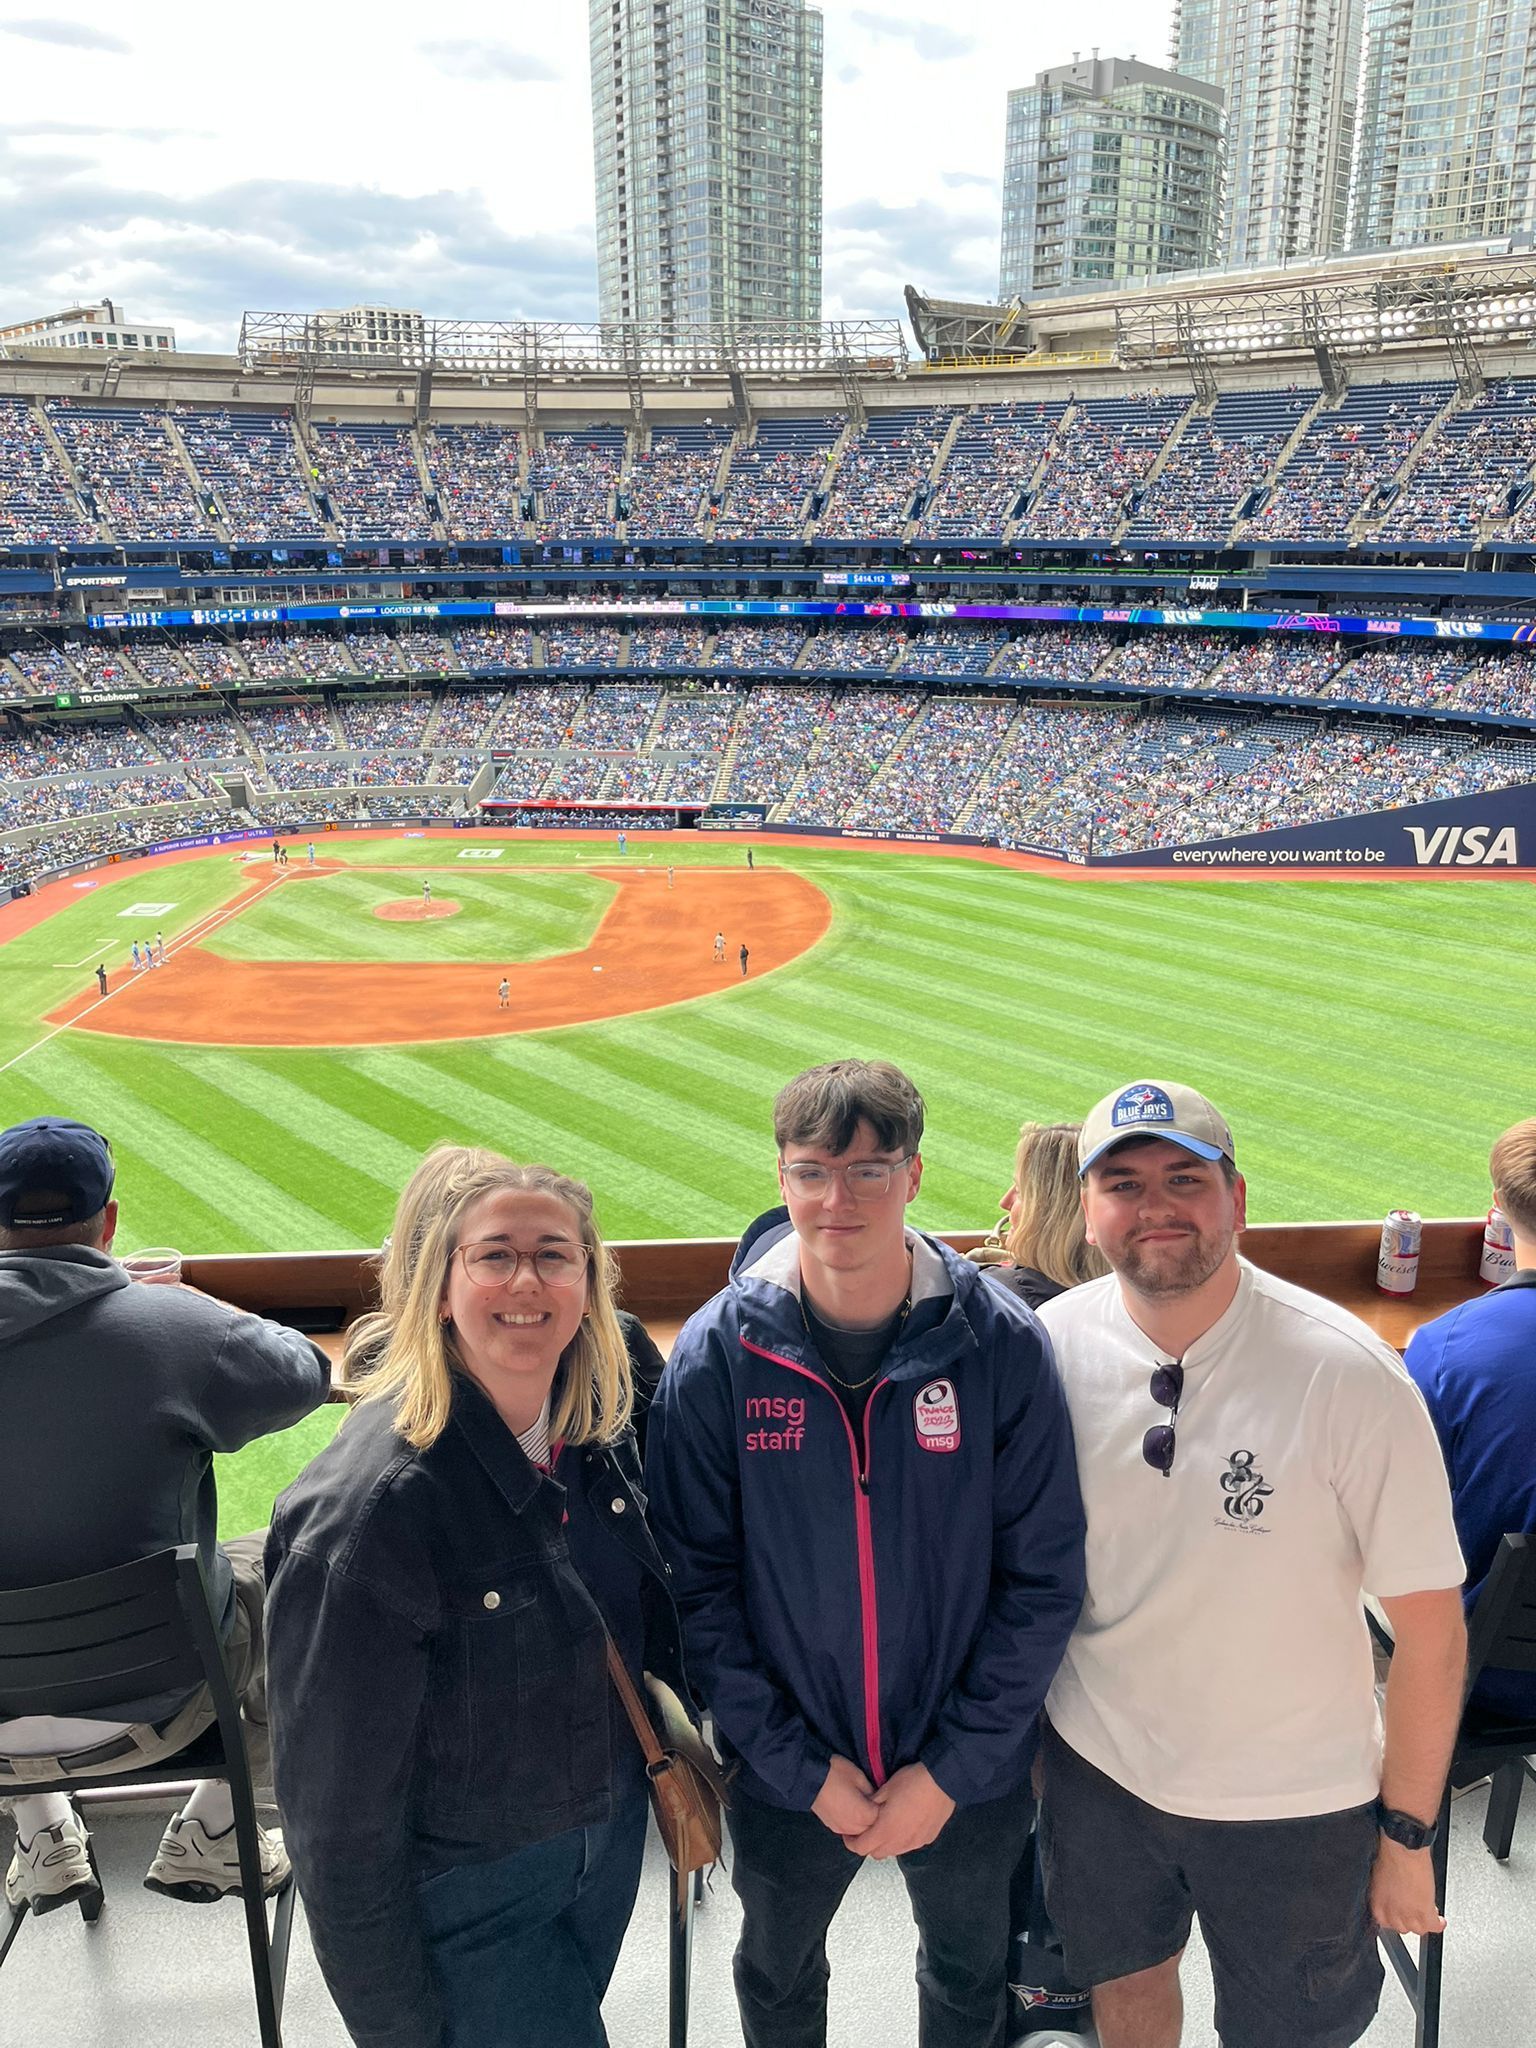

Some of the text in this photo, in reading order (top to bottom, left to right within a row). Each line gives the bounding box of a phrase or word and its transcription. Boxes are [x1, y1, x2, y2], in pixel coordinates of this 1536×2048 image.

[66, 576, 127, 587] SPORTSNET
[1189, 582, 1218, 590] KPMG
[79, 693, 139, 703] TD Clubhouse
[1403, 826, 1517, 864] VISA
[1067, 853, 1086, 865] VISA
[1173, 847, 1385, 864] everywhere you want to be
[1118, 1103, 1167, 1121] BLUE JAYS
[746, 1397, 806, 1425] msg
[746, 1427, 806, 1451] staff
[926, 1436, 955, 1449] msg
